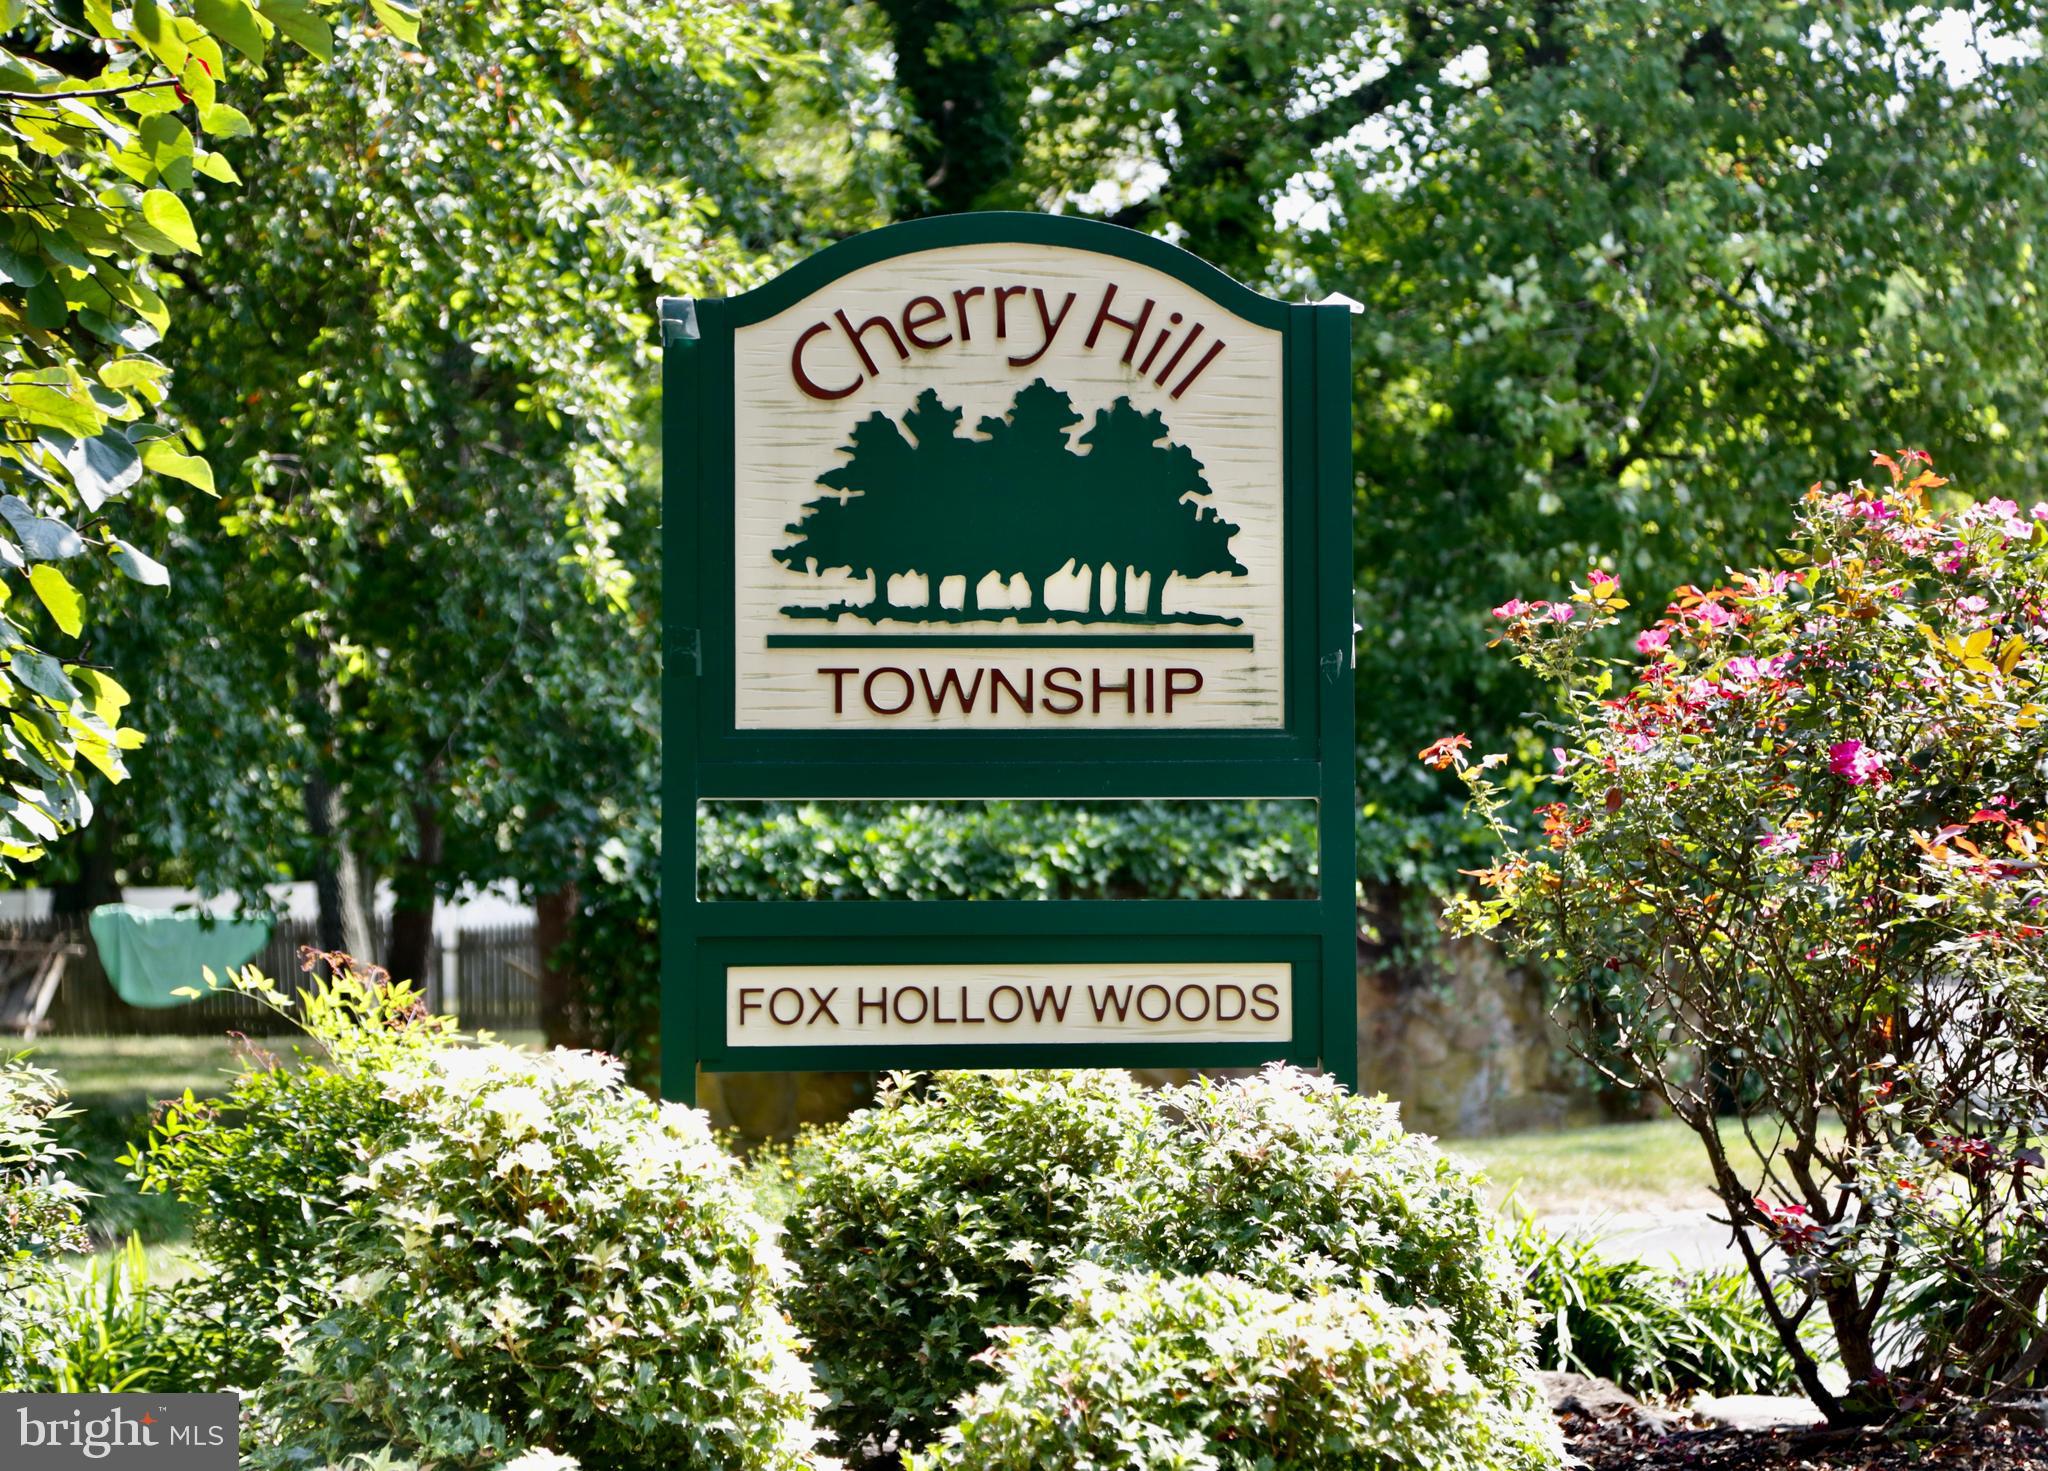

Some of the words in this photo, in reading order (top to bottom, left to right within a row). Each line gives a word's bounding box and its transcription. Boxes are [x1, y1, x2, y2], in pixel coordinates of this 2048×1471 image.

[791, 285, 1076, 401] Cherry
[1085, 283, 1226, 400] Hill
[818, 667, 1204, 716] TOWNSHIP
[739, 987, 839, 1026] FOX
[858, 985, 1072, 1025] HOLLOW
[1088, 983, 1281, 1023] WOODS
